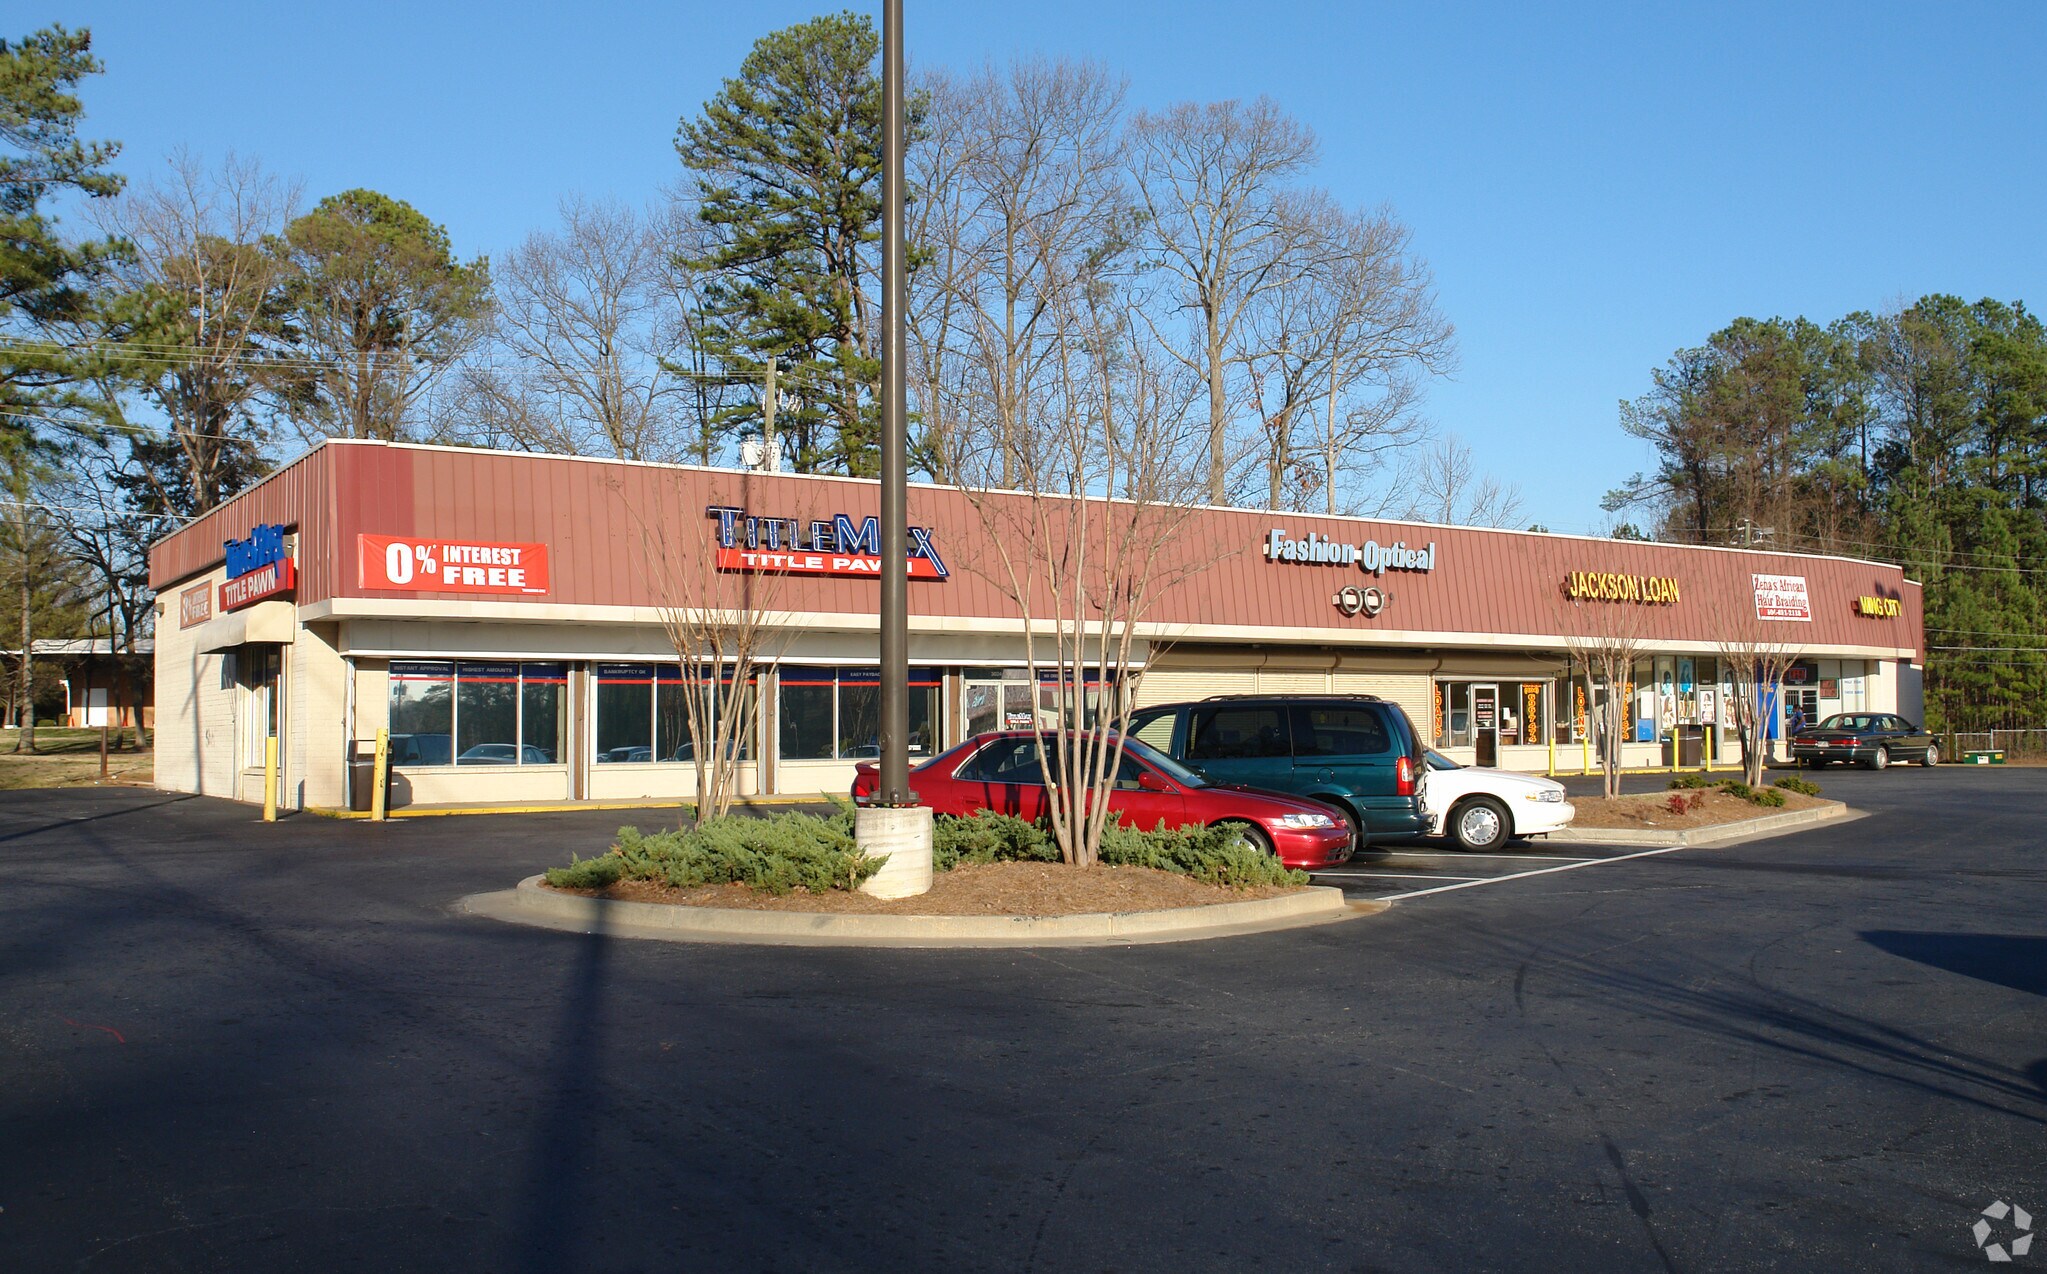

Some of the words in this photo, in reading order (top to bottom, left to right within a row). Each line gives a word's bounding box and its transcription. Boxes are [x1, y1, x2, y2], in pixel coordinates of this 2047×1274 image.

[706, 505, 950, 577] TITLEMX
[1270, 528, 1355, 564] Fashion
[1363, 540, 1436, 574] Optical
[442, 544, 522, 566] INTEREST
[741, 552, 824, 570] TITLE
[225, 579, 247, 606] TITLE
[247, 567, 276, 599] PAWN
[442, 566, 527, 587] FREE
[1569, 571, 1640, 600] JACKSON
[1640, 576, 1680, 603] LOAN
[1779, 579, 1805, 592] African
[1757, 594, 1774, 606] Hair
[1775, 595, 1808, 613] Braiding
[1860, 596, 1884, 615] WING
[1884, 598, 1902, 617] CITY
[1434, 684, 1443, 738] LOANS
[1577, 686, 1585, 735] LOANS
